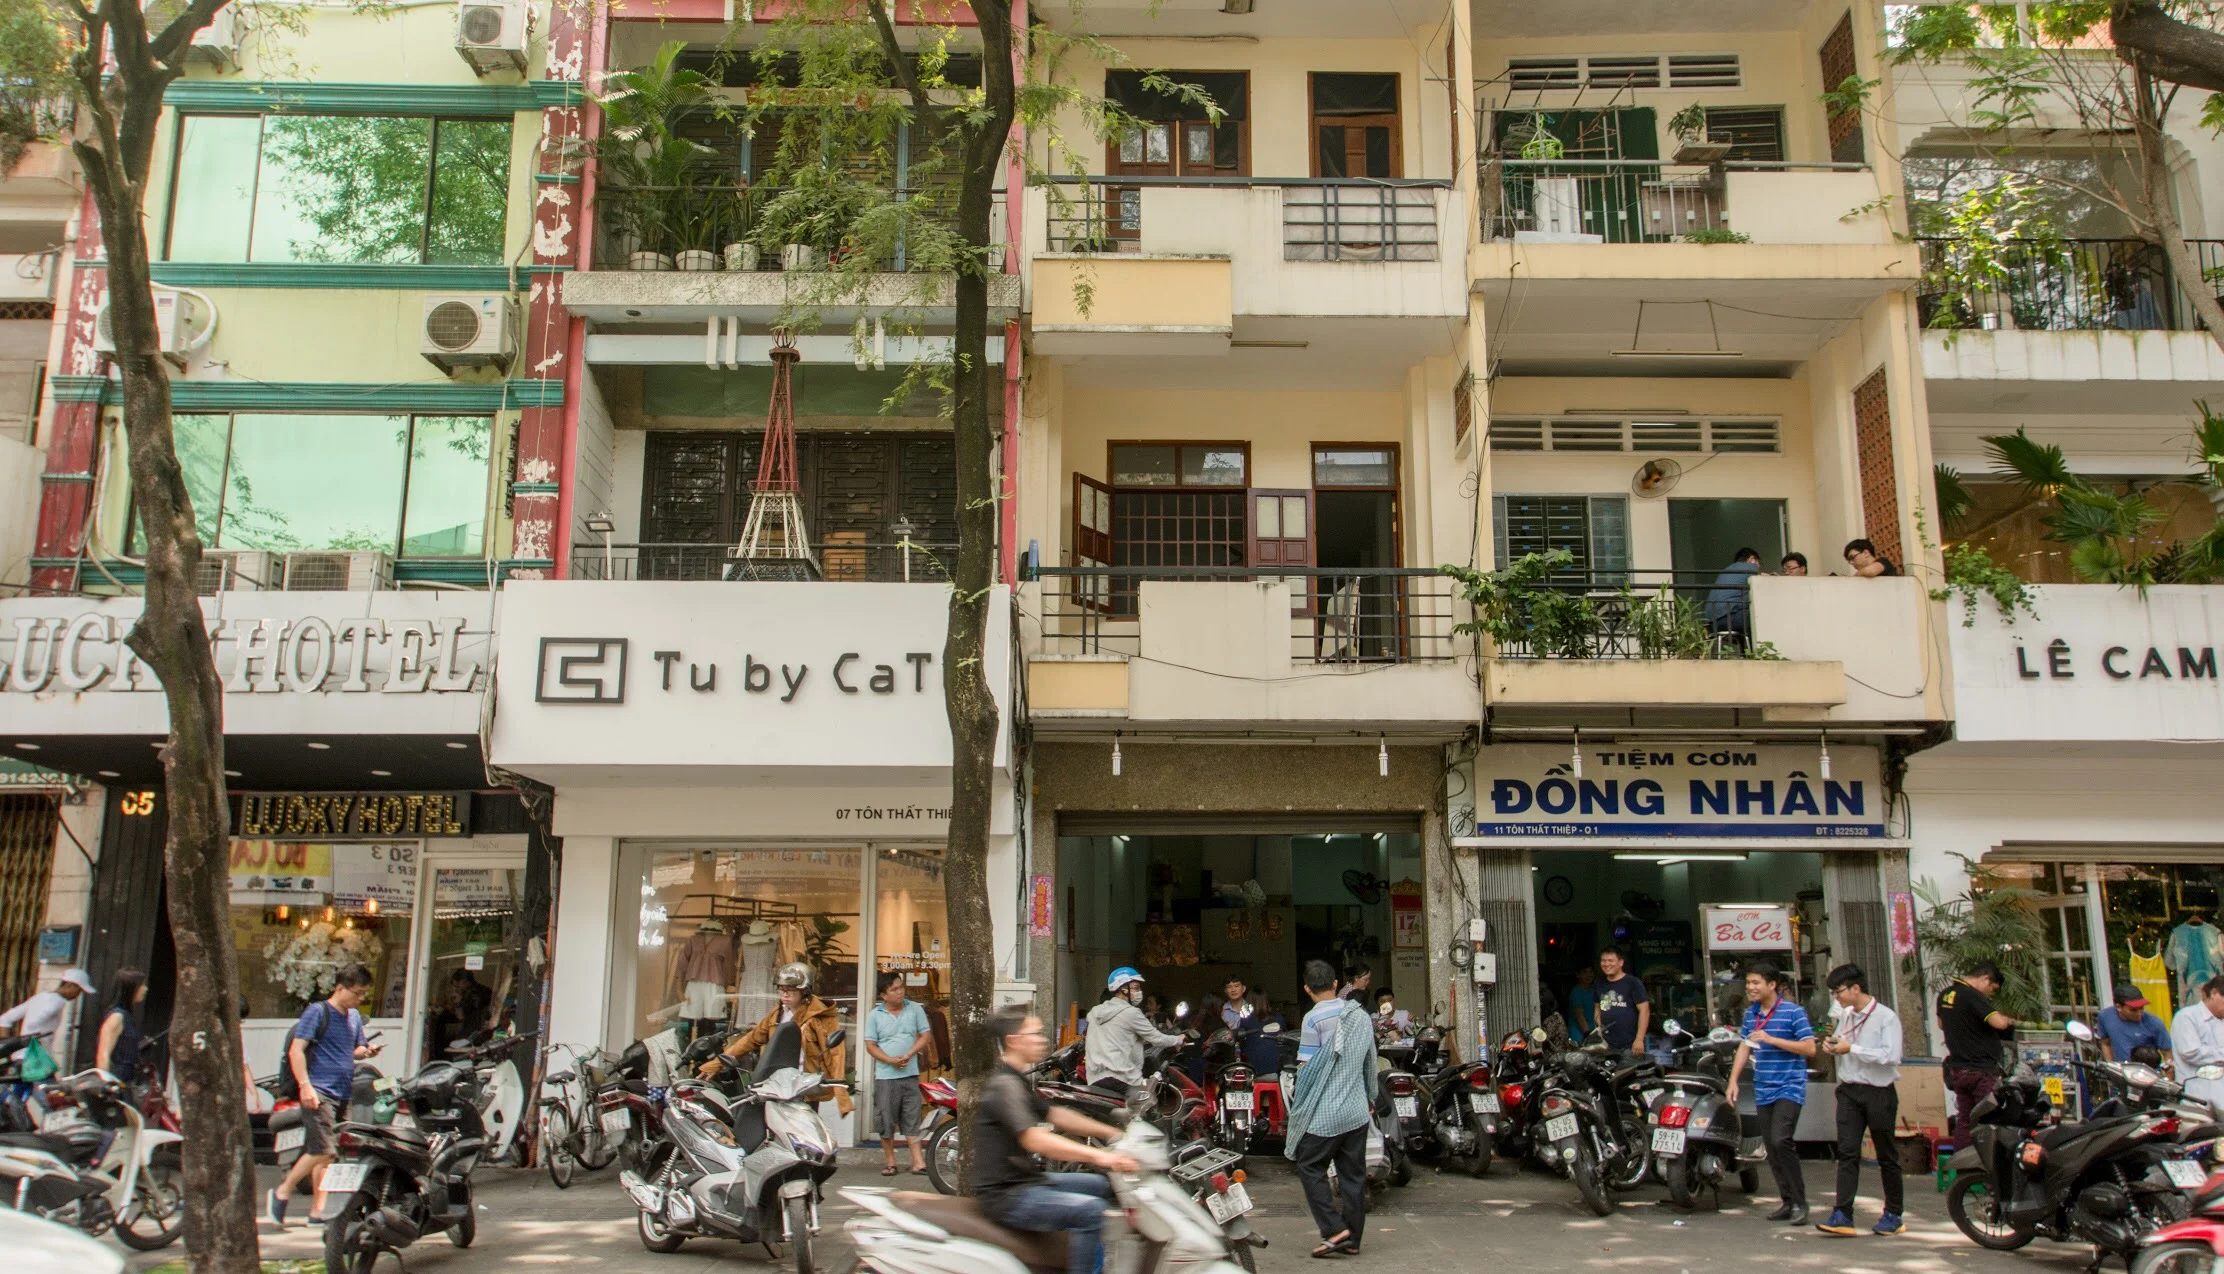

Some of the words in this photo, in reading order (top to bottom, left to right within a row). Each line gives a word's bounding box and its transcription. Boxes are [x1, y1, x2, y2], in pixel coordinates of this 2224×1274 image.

[225, 616, 481, 694] HOTEL
[2016, 638, 2075, 679] LÊ
[654, 650, 717, 692] Tu
[744, 654, 808, 702] by
[833, 652, 932, 693] CaT
[1596, 749, 1675, 770] TIỆM
[1687, 750, 1757, 767] CƠM
[1491, 763, 1665, 816] ĐỒNG
[1690, 770, 1865, 816] NHÂN
[244, 796, 351, 835] LUCKY
[357, 795, 463, 834] HOTEL
[836, 808, 851, 820] 07
[854, 805, 883, 820] TÔN
[886, 803, 924, 820] THẤT
[1494, 826, 1504, 835] 11
[1506, 823, 1525, 835] TÔN
[1526, 822, 1550, 835] THẤT
[1399, 914, 1416, 931] 17
[1715, 923, 1745, 942] Bà
[905, 951, 920, 959] Are
[922, 951, 946, 960] Open
